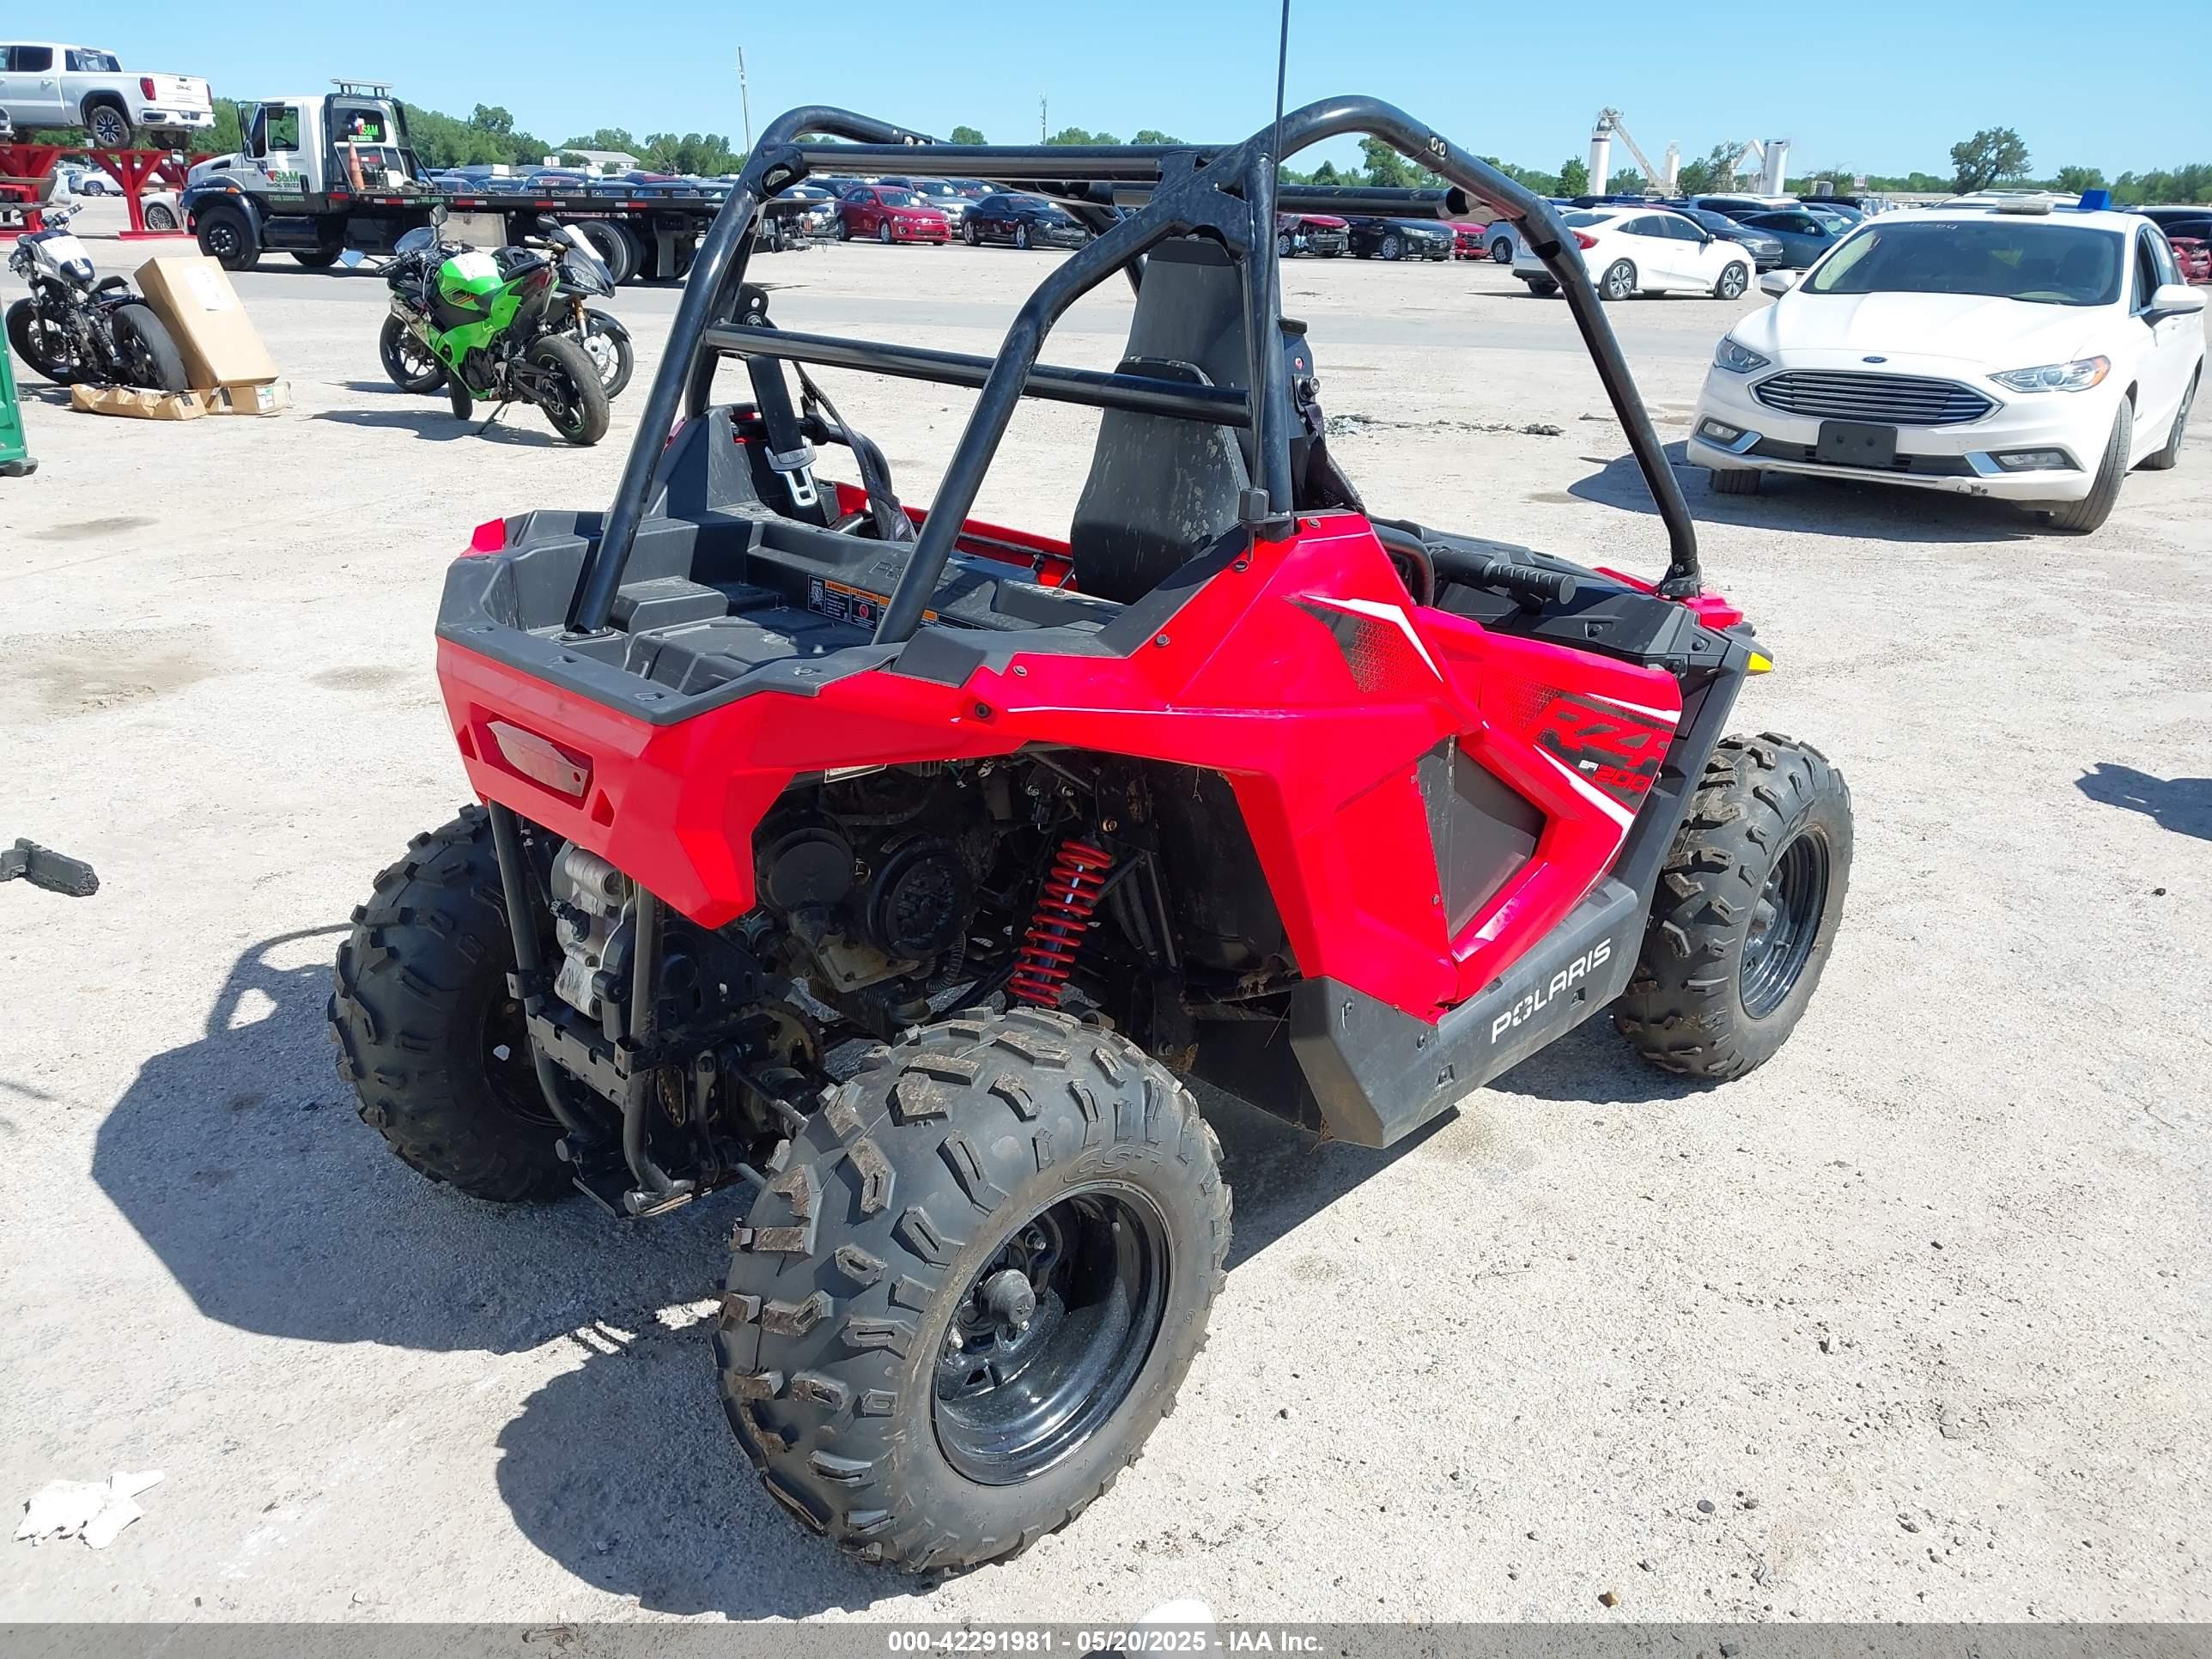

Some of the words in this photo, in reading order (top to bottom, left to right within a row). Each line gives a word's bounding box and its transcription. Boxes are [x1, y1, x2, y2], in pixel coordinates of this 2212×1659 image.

[362, 125, 379, 136] S&M
[275, 171, 299, 182] S&M
[1578, 759, 1599, 771] EFI
[1593, 765, 1652, 793] 200
[1492, 937, 1612, 1044] POLARIS
